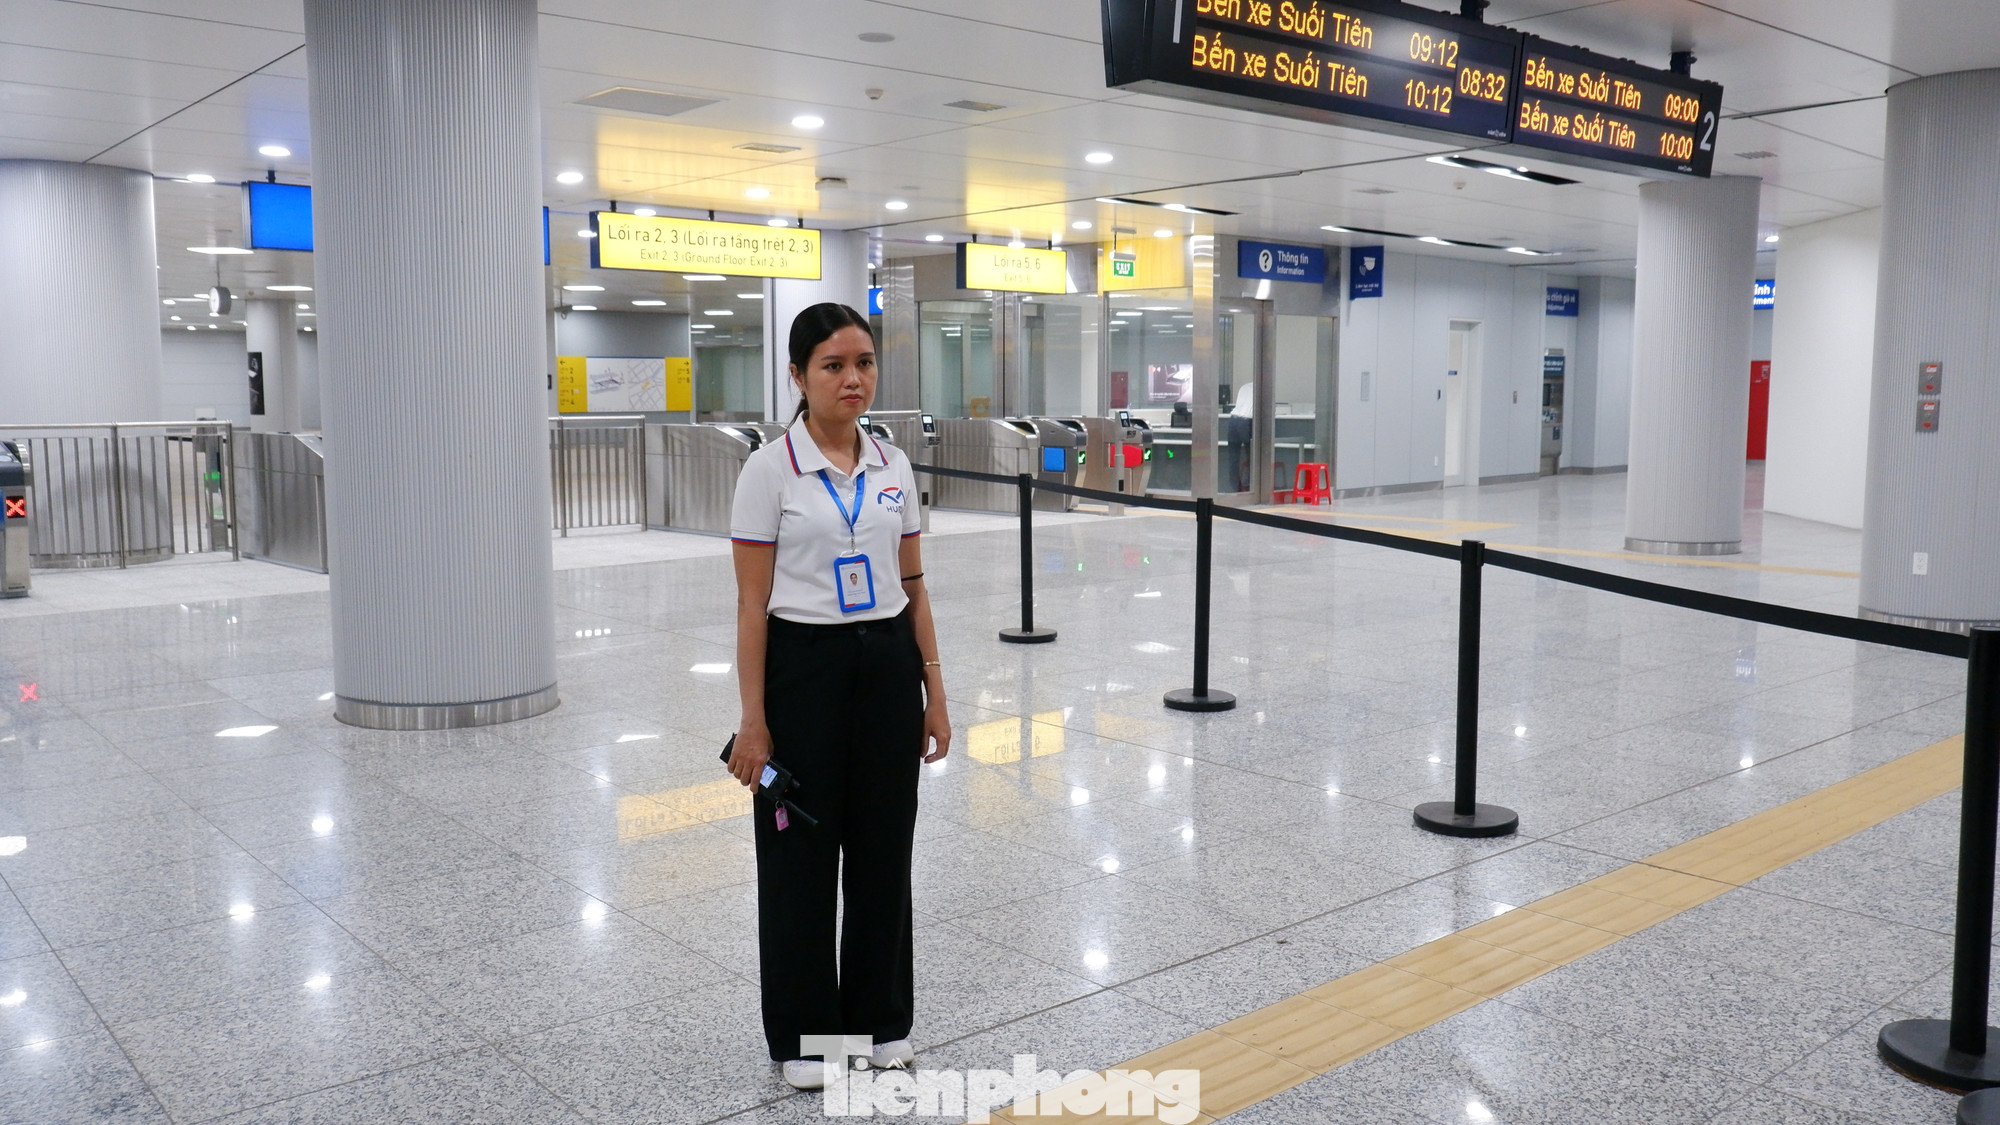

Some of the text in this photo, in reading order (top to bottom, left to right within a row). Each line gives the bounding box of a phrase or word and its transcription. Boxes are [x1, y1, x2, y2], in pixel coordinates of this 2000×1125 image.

[1247, 1, 1272, 27] xe
[1278, 1, 1325, 39] Suối
[1332, 12, 1373, 50] Tiên
[1410, 32, 1459, 69] 09:12
[1192, 32, 1452, 114] Bến xe Suối Tiên 10:12
[1460, 67, 1506, 101] 08:32
[1524, 57, 1700, 123] Bến xe Suối Tiên 09:00
[1519, 100, 1693, 160] Bến xe Suối Tiên 10:00
[1700, 111, 1715, 151] 2
[608, 224, 630, 240] Lối
[635, 230, 650, 242] ra
[671, 229, 678, 244] 3
[683, 230, 708, 246] (Lối
[713, 236, 727, 247] ra
[803, 239, 814, 254] 3)
[640, 249, 659, 260] Exit
[682, 251, 720, 264] (Ground
[723, 254, 746, 265] Floor
[750, 256, 766, 267] Exit
[1277, 250, 1309, 266] Thông tin
